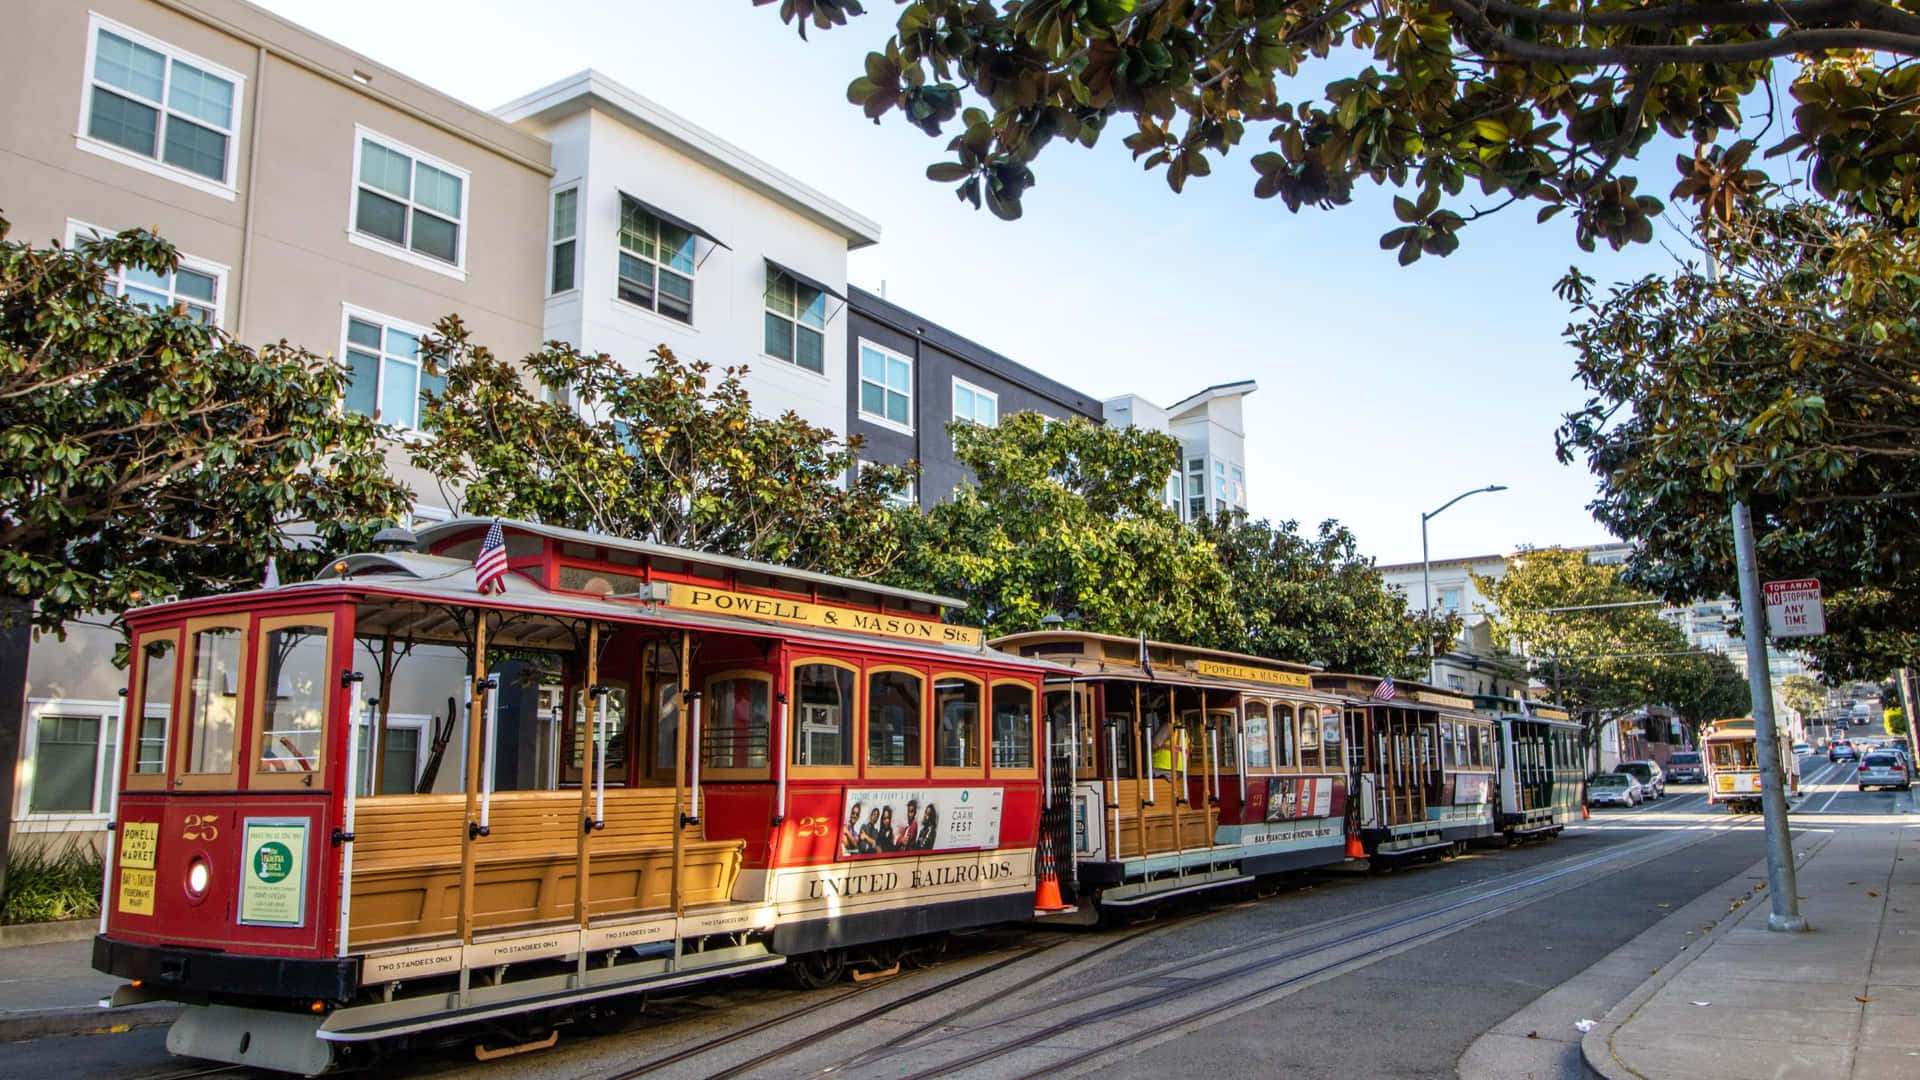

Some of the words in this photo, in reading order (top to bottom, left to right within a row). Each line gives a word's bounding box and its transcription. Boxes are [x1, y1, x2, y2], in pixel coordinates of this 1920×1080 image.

[1767, 592, 1781, 605] NO
[1783, 591, 1818, 602] STOPPING
[691, 591, 808, 620] POWELL
[823, 610, 839, 625] &
[853, 614, 933, 637] MASON
[1785, 604, 1804, 614] ANY
[1784, 615, 1807, 625] TIME
[1203, 663, 1245, 677] POWELL
[1260, 671, 1291, 682] MASON
[182, 814, 218, 841] 25
[798, 816, 828, 837] 25
[951, 822, 972, 832] FEST
[125, 829, 155, 840] POWELL
[131, 841, 147, 849] AND
[122, 850, 153, 861] MARKET
[808, 871, 898, 899] UNITED
[911, 861, 1013, 888] RAILROADS.
[712, 917, 736, 926] STANDEES
[737, 915, 749, 923] ONLY
[619, 929, 647, 938] STANDEES
[648, 927, 661, 935] ONLY
[494, 947, 508, 956] TWO
[509, 943, 541, 953] STANDEES
[542, 940, 558, 948] ONLY
[378, 963, 394, 972] TWO
[397, 957, 434, 969] STANDEES
[435, 955, 452, 964] ONLY
